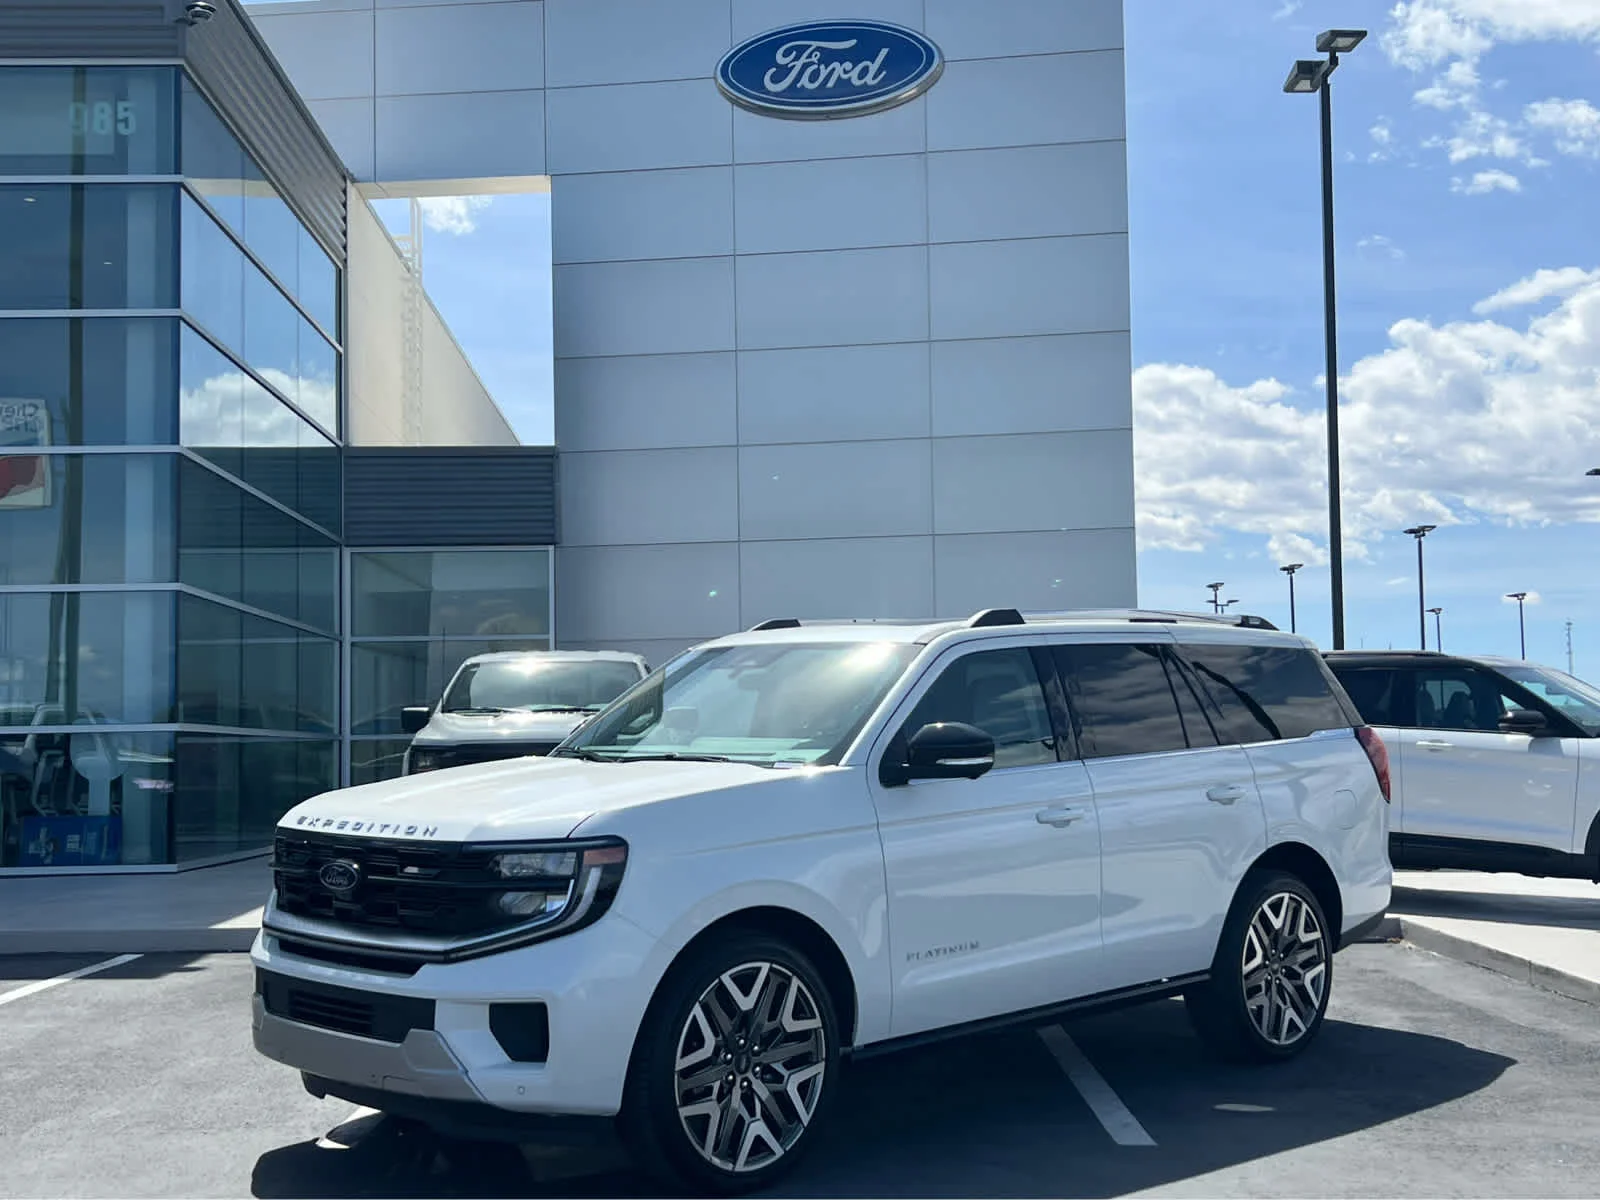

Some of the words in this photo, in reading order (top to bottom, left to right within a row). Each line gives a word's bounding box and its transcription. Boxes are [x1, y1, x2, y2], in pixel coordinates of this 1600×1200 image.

[763, 39, 890, 92] Ford
[69, 100, 136, 136] 985
[297, 815, 438, 838] EXPEDITION
[325, 865, 349, 886] Ford
[906, 940, 980, 962] PLATINUM
